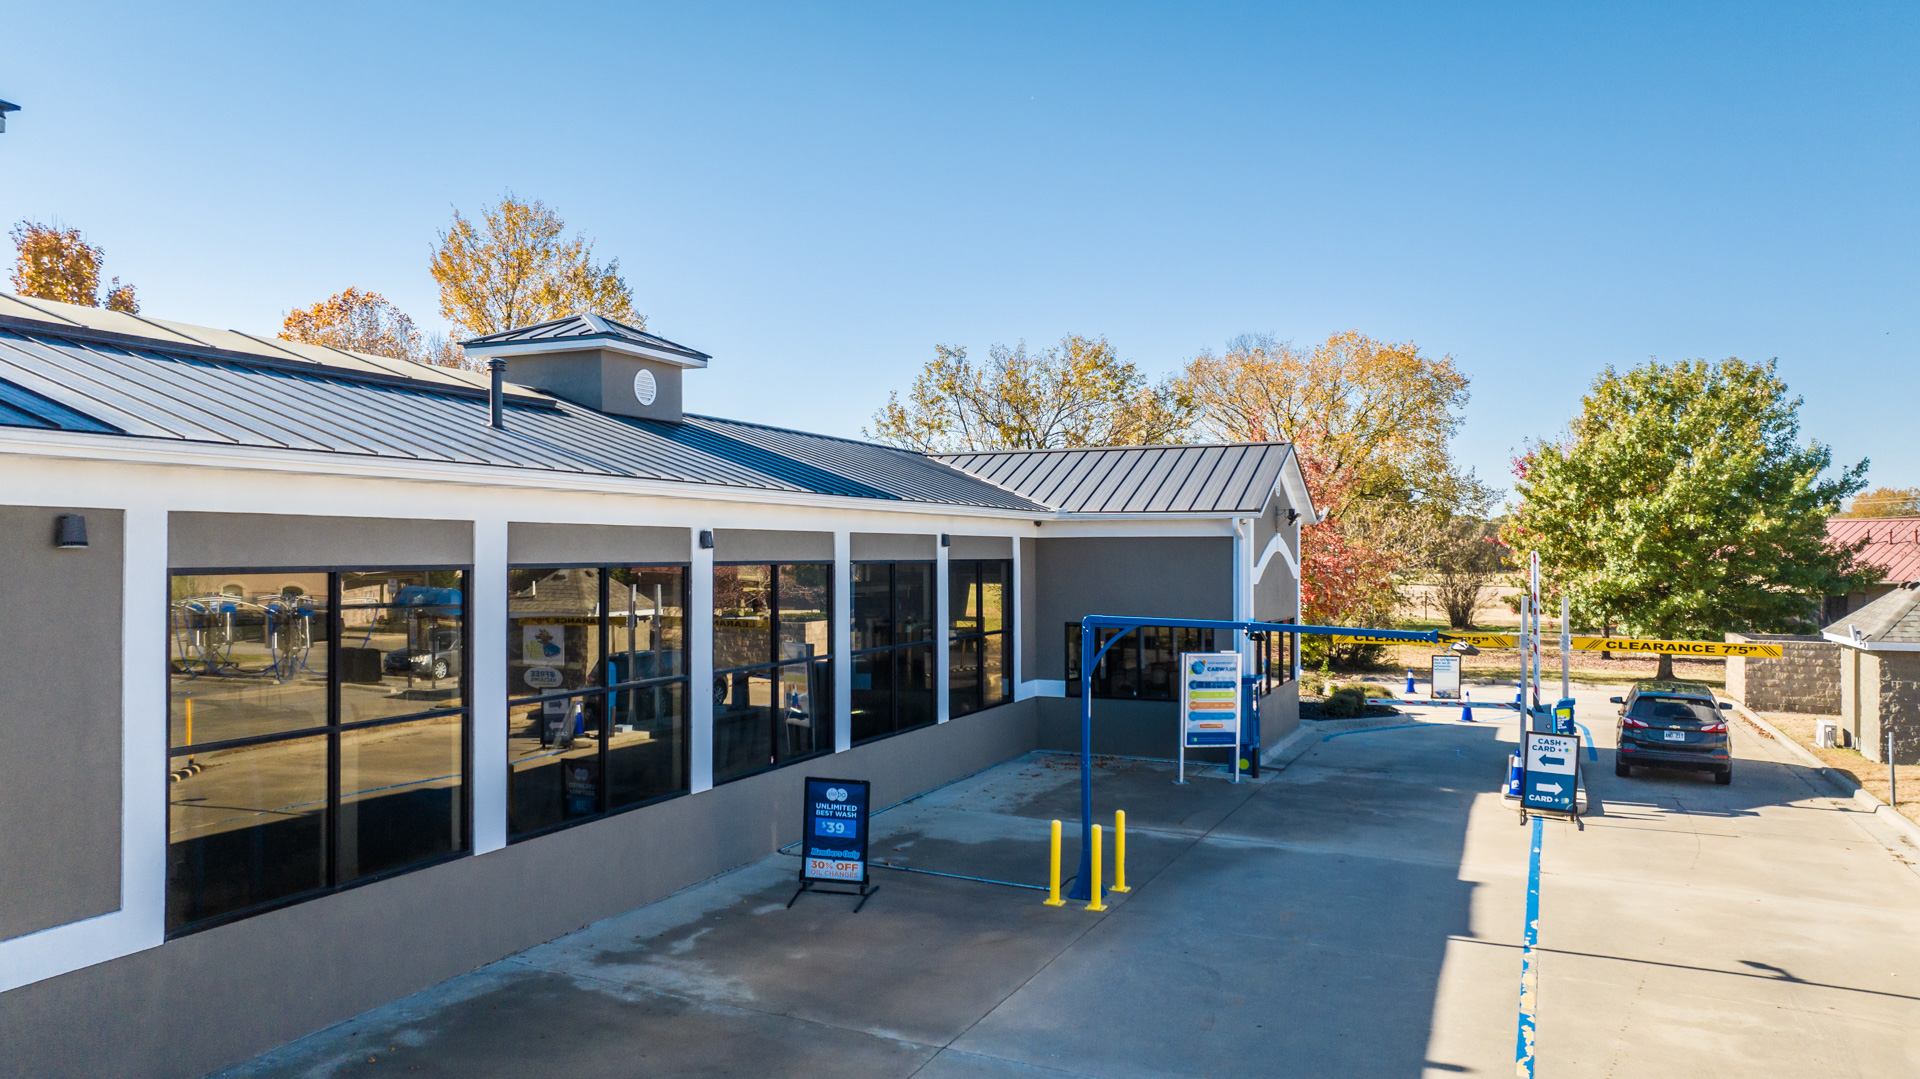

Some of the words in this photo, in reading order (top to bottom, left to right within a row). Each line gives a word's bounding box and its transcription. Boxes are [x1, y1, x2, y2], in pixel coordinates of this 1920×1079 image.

[1354, 635, 1452, 644] CLEARE
[1605, 641, 1716, 653] CLEARANCE
[1537, 738, 1561, 746] CASH
[1532, 744, 1556, 753] CARD
[1528, 794, 1553, 803] CARD
[815, 802, 858, 812] UNLIMITED
[815, 809, 834, 817] BEST
[835, 810, 857, 818] WASH
[811, 847, 843, 858] Members
[811, 860, 833, 870] 30%
[836, 862, 859, 872] OFF
[824, 870, 858, 878] CHANGES
